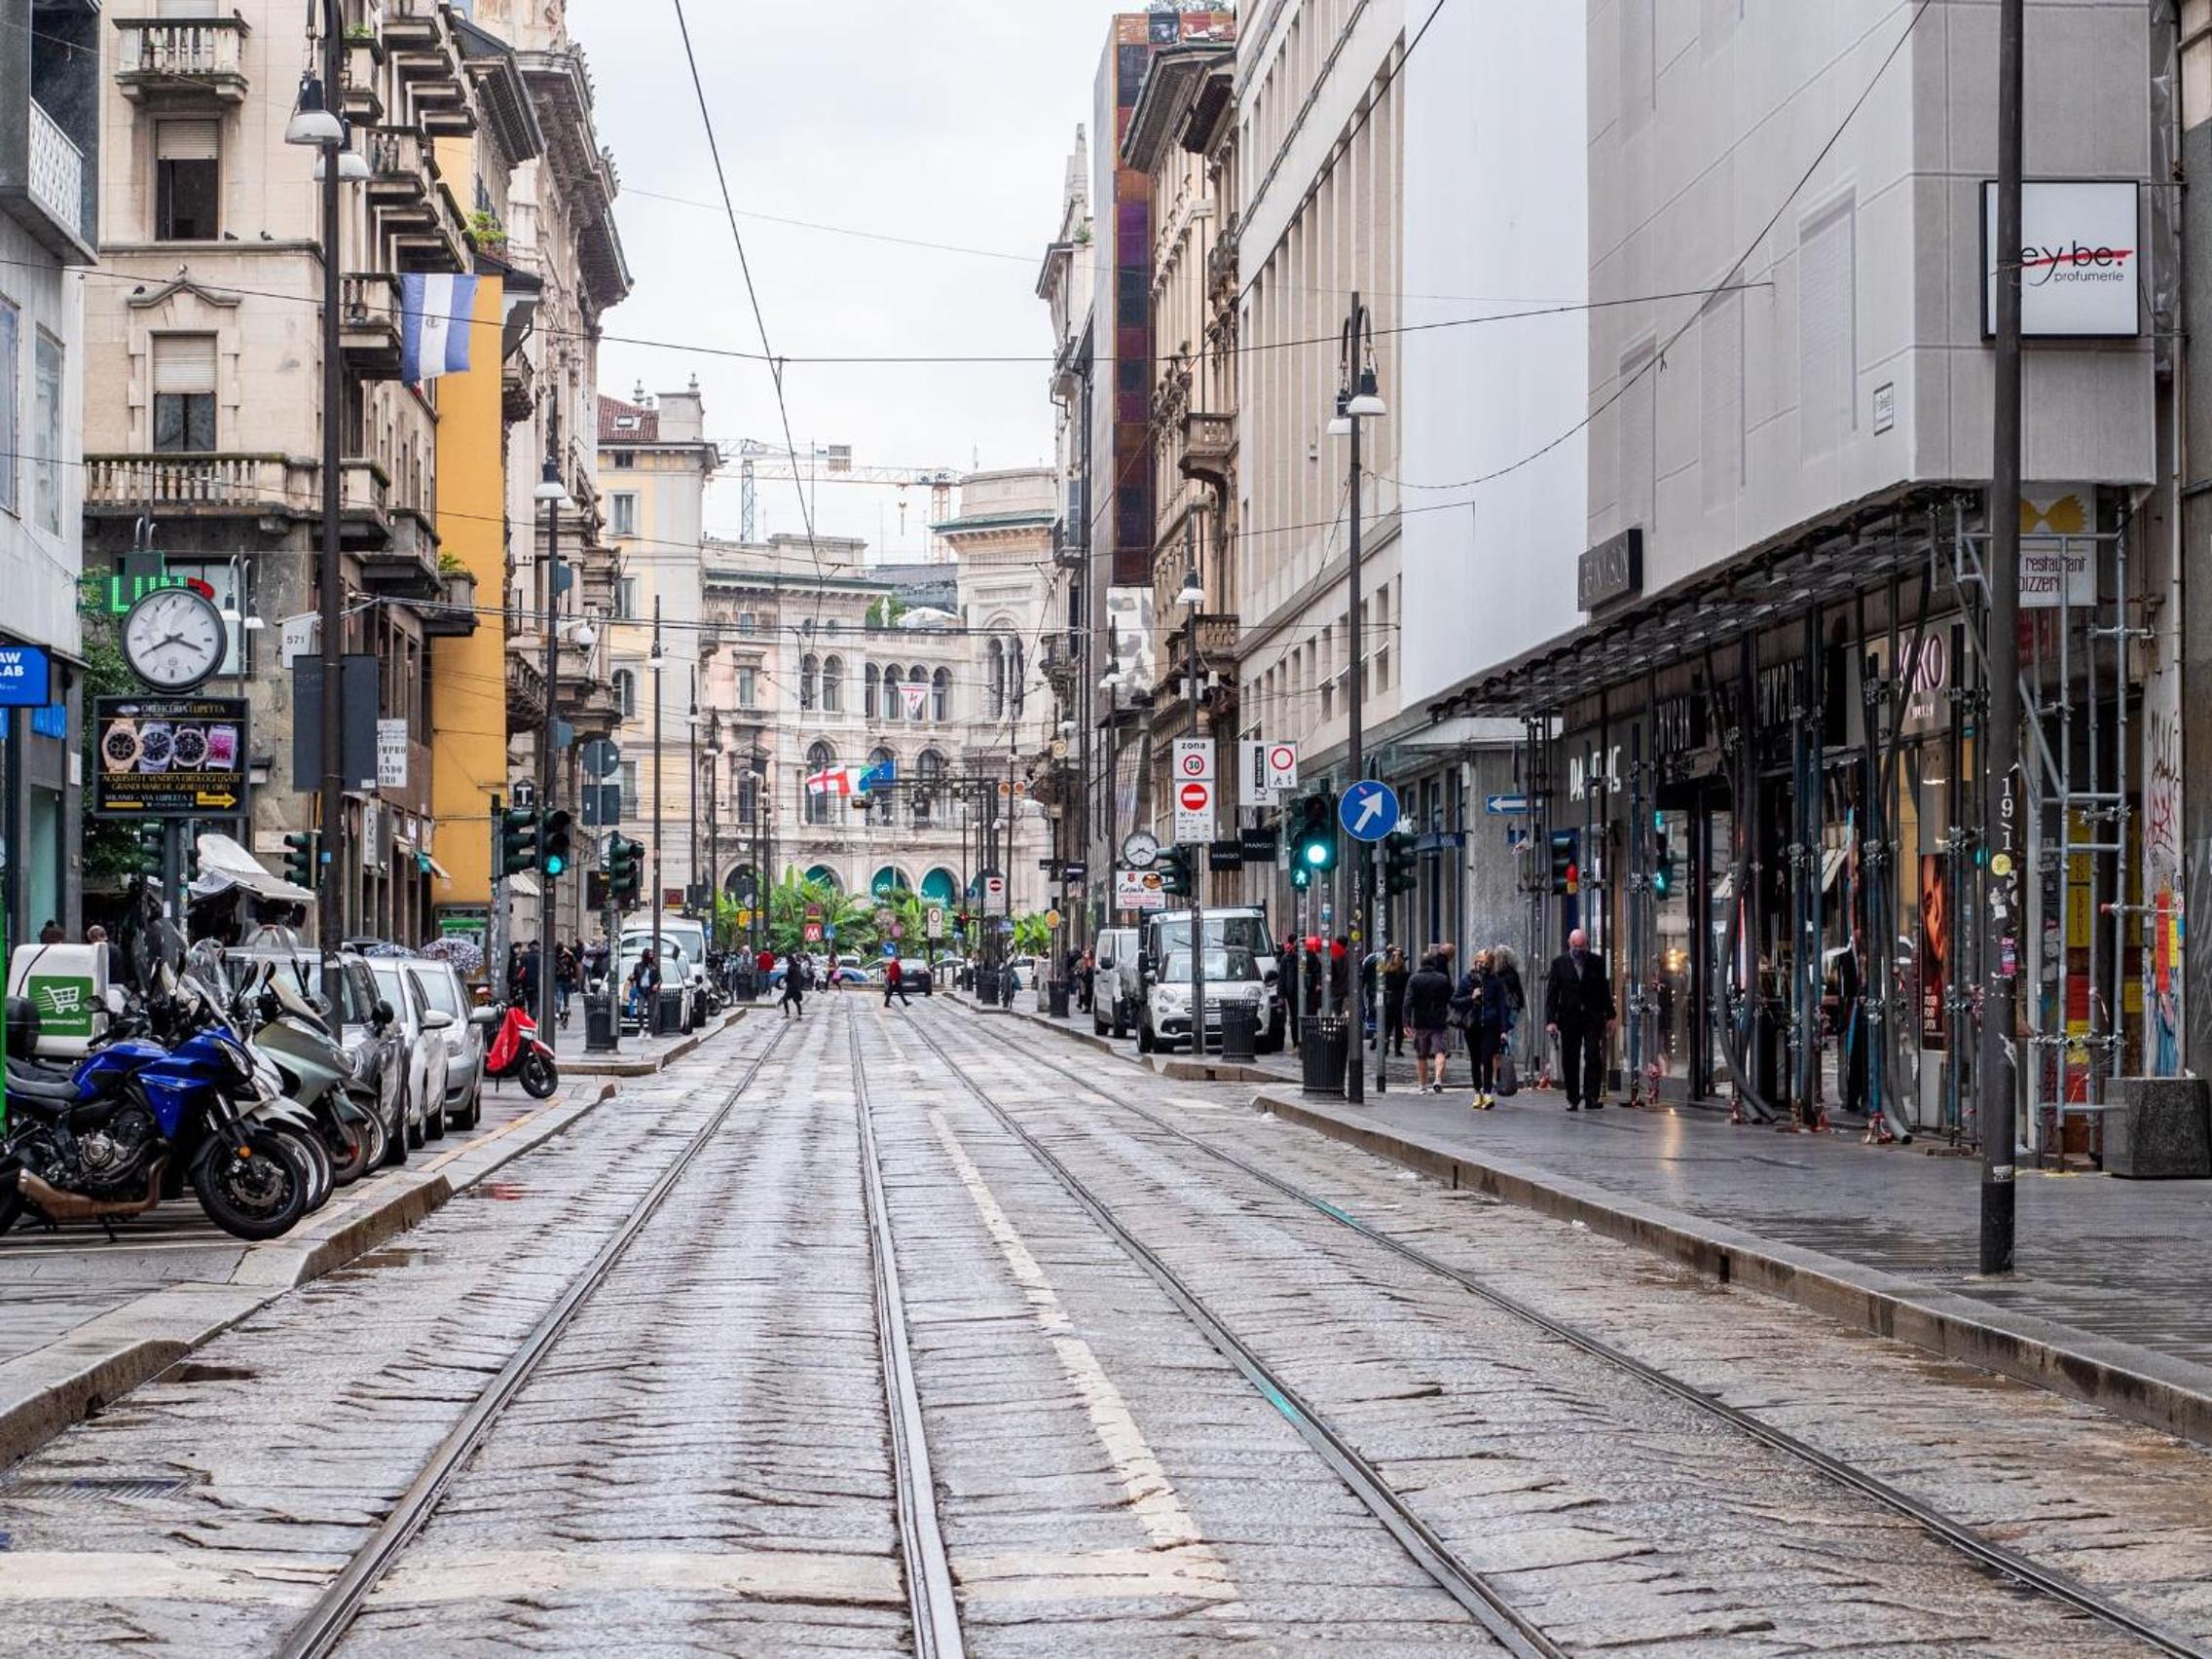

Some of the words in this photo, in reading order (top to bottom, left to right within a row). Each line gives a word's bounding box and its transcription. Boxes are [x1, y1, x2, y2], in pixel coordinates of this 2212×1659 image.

[2054, 270, 2124, 282] profumerie
[2026, 555, 2087, 572] restauant
[1758, 659, 1802, 727] WYCO
[516, 787, 532, 804] T
